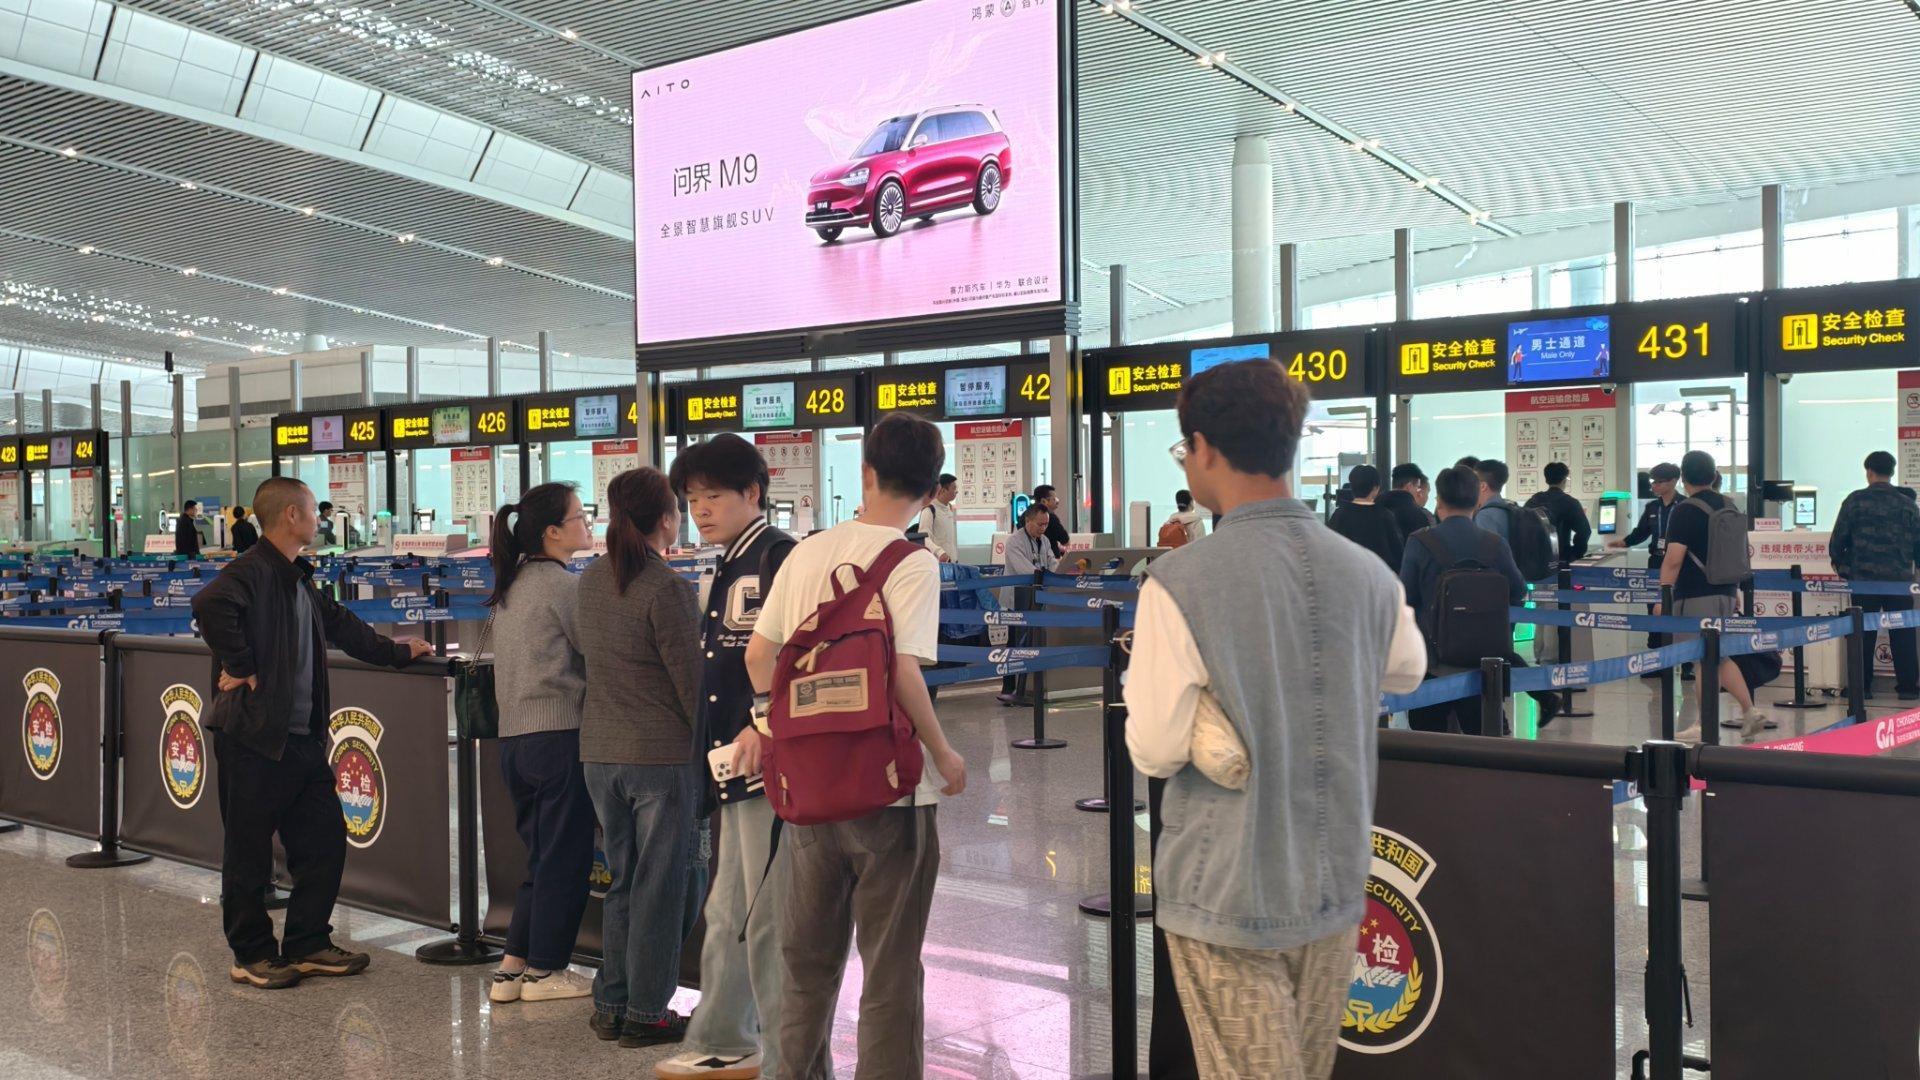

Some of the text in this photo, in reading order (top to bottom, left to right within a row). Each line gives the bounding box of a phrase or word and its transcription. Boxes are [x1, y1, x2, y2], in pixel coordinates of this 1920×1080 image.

[641, 79, 690, 99] AITO
[673, 153, 758, 198] 问界 M9
[660, 206, 775, 239] 全景智慧旗舰SUV
[996, 280, 1011, 289] 华为
[1018, 275, 1049, 287] 联合设计
[1822, 307, 1905, 332] 安全检查
[1531, 335, 1586, 351] 男士通道
[1637, 322, 1710, 359] 431
[1822, 331, 1905, 346] Security Check
[1432, 339, 1496, 359] 安全检查
[1541, 350, 1576, 360] Male Only
[1132, 363, 1182, 380] 安全检查
[1288, 350, 1347, 382] 430
[1432, 359, 1496, 371] Security Check
[898, 382, 937, 397] 安全检查
[1020, 373, 1051, 401] 42
[1132, 381, 1182, 392] Security Check
[704, 396, 737, 409] 安全检查
[805, 388, 845, 414] 428
[897, 397, 937, 408] Security Check
[478, 411, 506, 433] 426
[542, 407, 570, 420] 安全检查
[350, 421, 375, 441] 425
[1, 446, 16, 462] 423
[76, 441, 93, 458] 424
[1761, 543, 1826, 554] 违规携带火种
[1613, 591, 1631, 603] GA
[984, 611, 999, 624] GA
[1575, 613, 1596, 627] GA
[988, 649, 1010, 663] GA
[331, 711, 380, 739] 中华人民共和国
[1876, 718, 1895, 749] GA
[172, 741, 195, 759] 安检
[334, 740, 379, 772] CHINA SECURITY
[341, 771, 371, 793] 安检
[1364, 880, 1422, 932] ECURITY
[1372, 933, 1400, 965] 检
